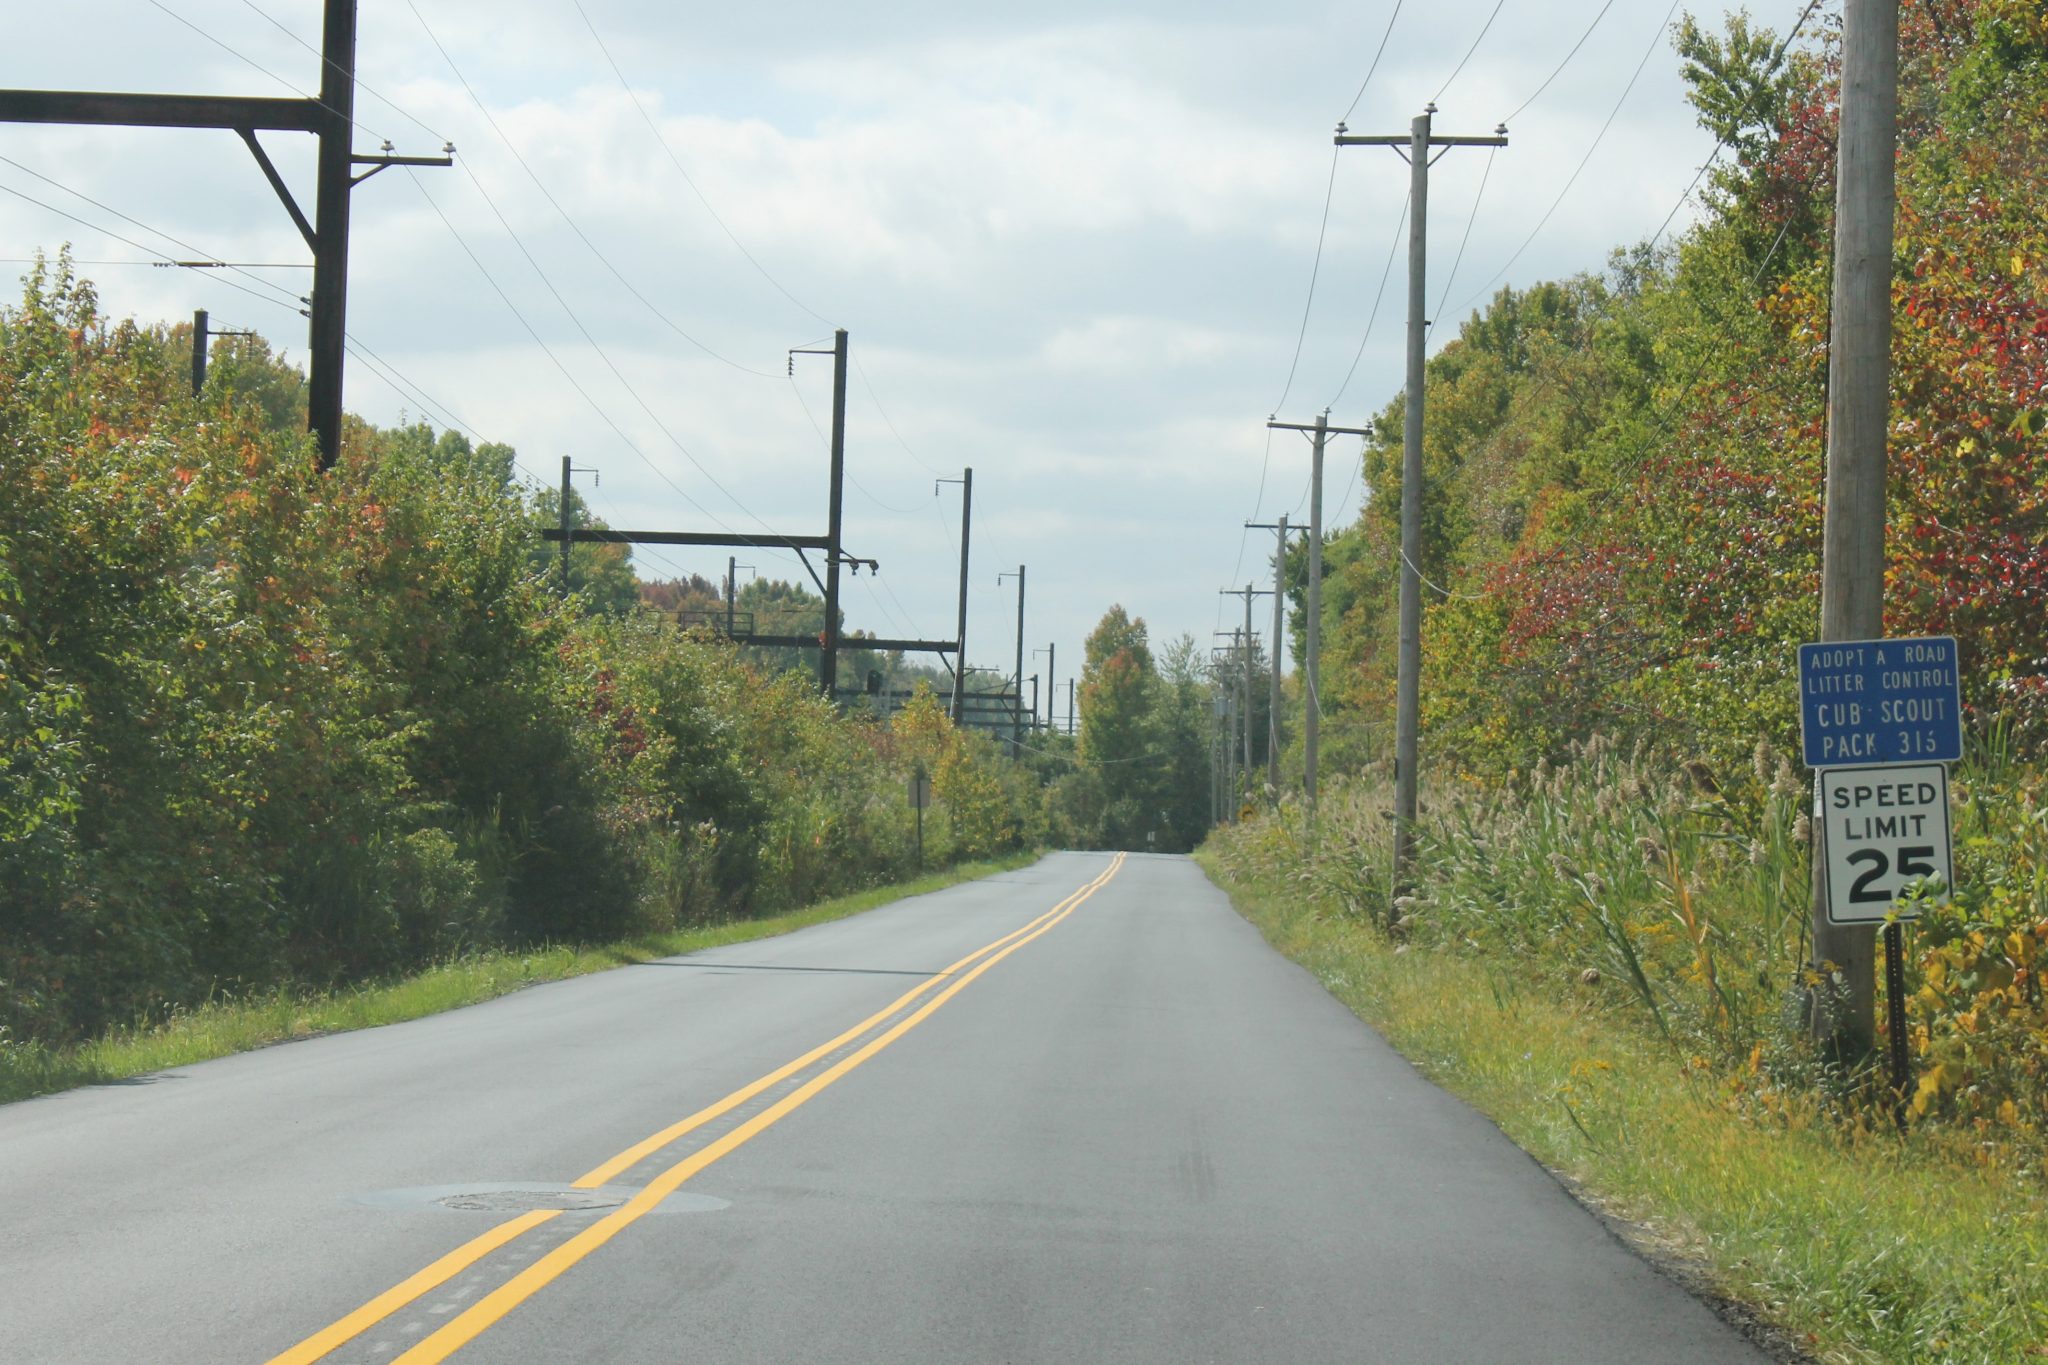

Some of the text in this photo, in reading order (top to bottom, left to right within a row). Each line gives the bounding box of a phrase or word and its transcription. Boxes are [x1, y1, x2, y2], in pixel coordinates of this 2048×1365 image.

[1811, 645, 1945, 669] ADOPT A ROAD
[1809, 669, 1952, 694] LITTER CONTROL
[1818, 698, 1944, 727] CUB SCOUT
[1823, 733, 1876, 759] PACK
[1833, 783, 1936, 809] SPEED
[1845, 814, 1926, 840] LIMIT
[1845, 845, 1940, 903] 25
